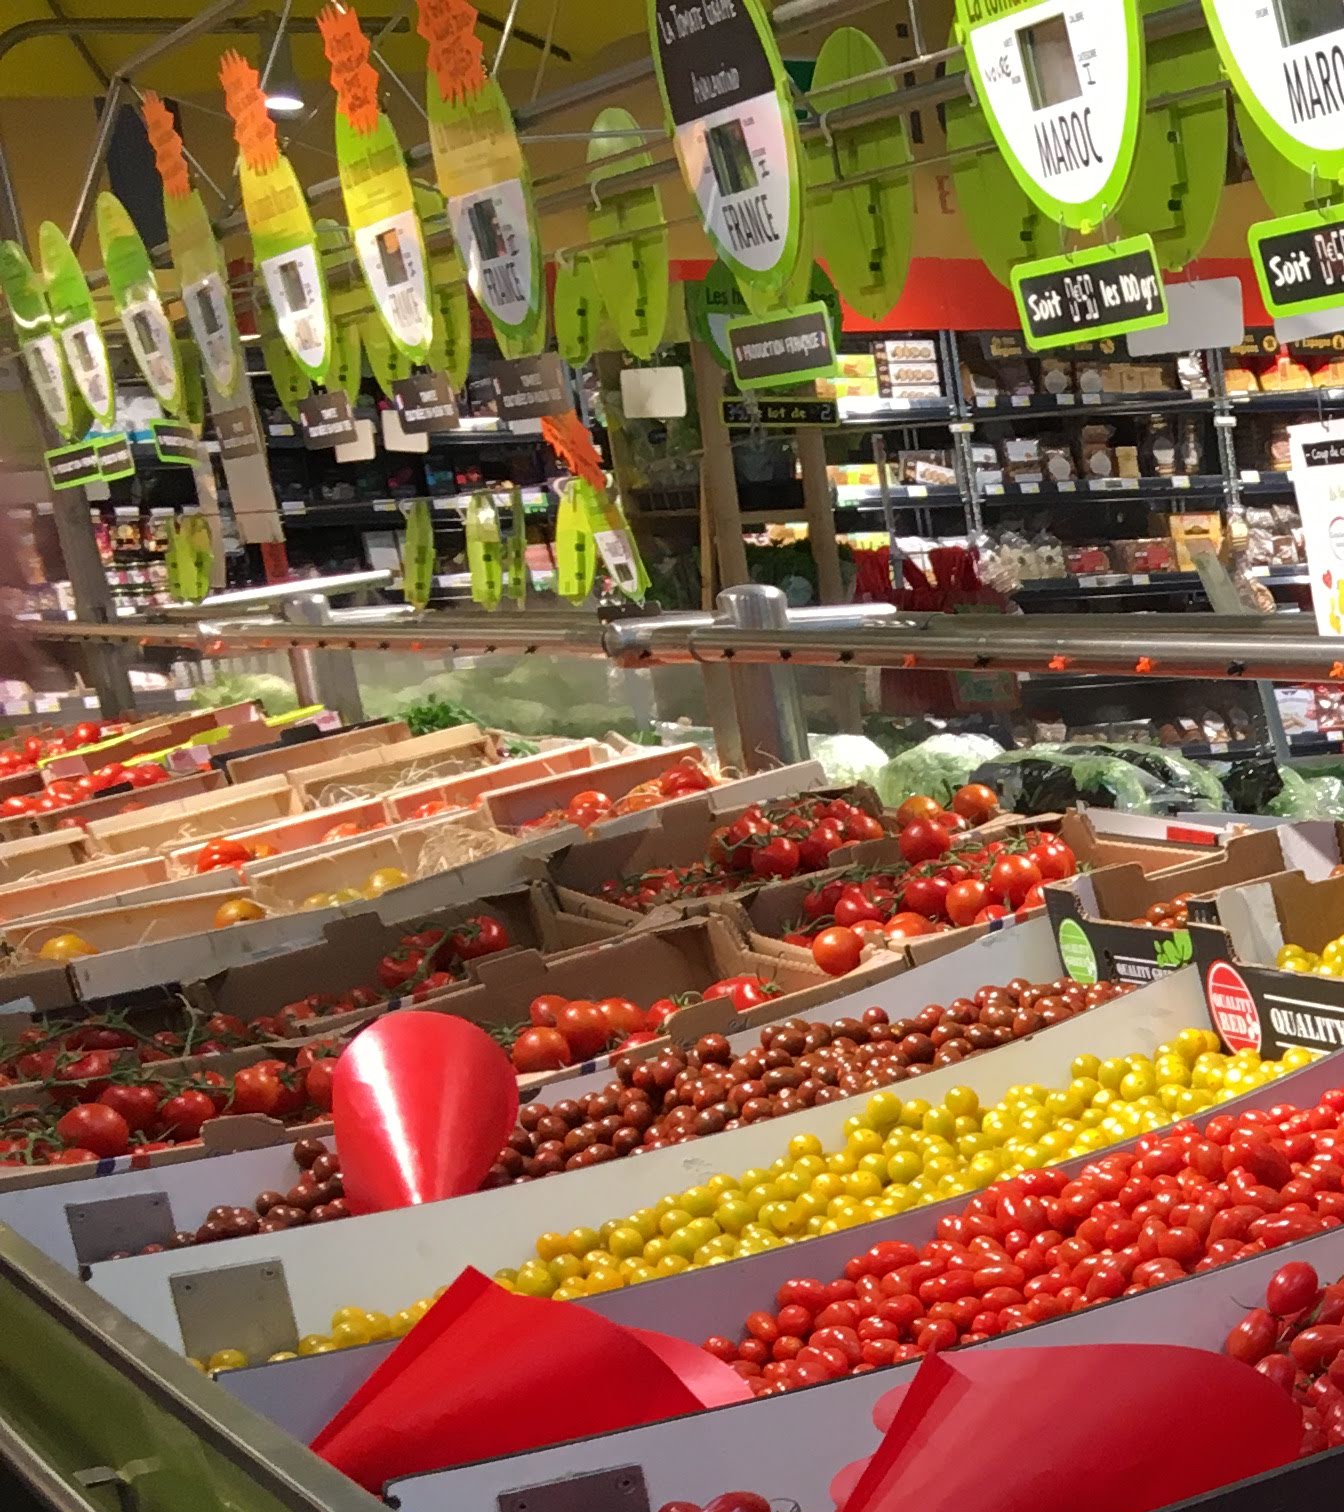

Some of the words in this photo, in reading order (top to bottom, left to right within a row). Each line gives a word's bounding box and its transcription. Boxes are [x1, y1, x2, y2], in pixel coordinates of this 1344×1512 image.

[1034, 107, 1103, 178] MAROC
[721, 193, 780, 251] FRANCE
[1269, 250, 1311, 287] Soit
[1028, 290, 1063, 322] Soit
[1099, 280, 1121, 307] les
[1119, 273, 1141, 303] 100
[1140, 275, 1158, 311] grs
[1212, 992, 1253, 1014] QUALITY
[1219, 1012, 1247, 1035] RED
